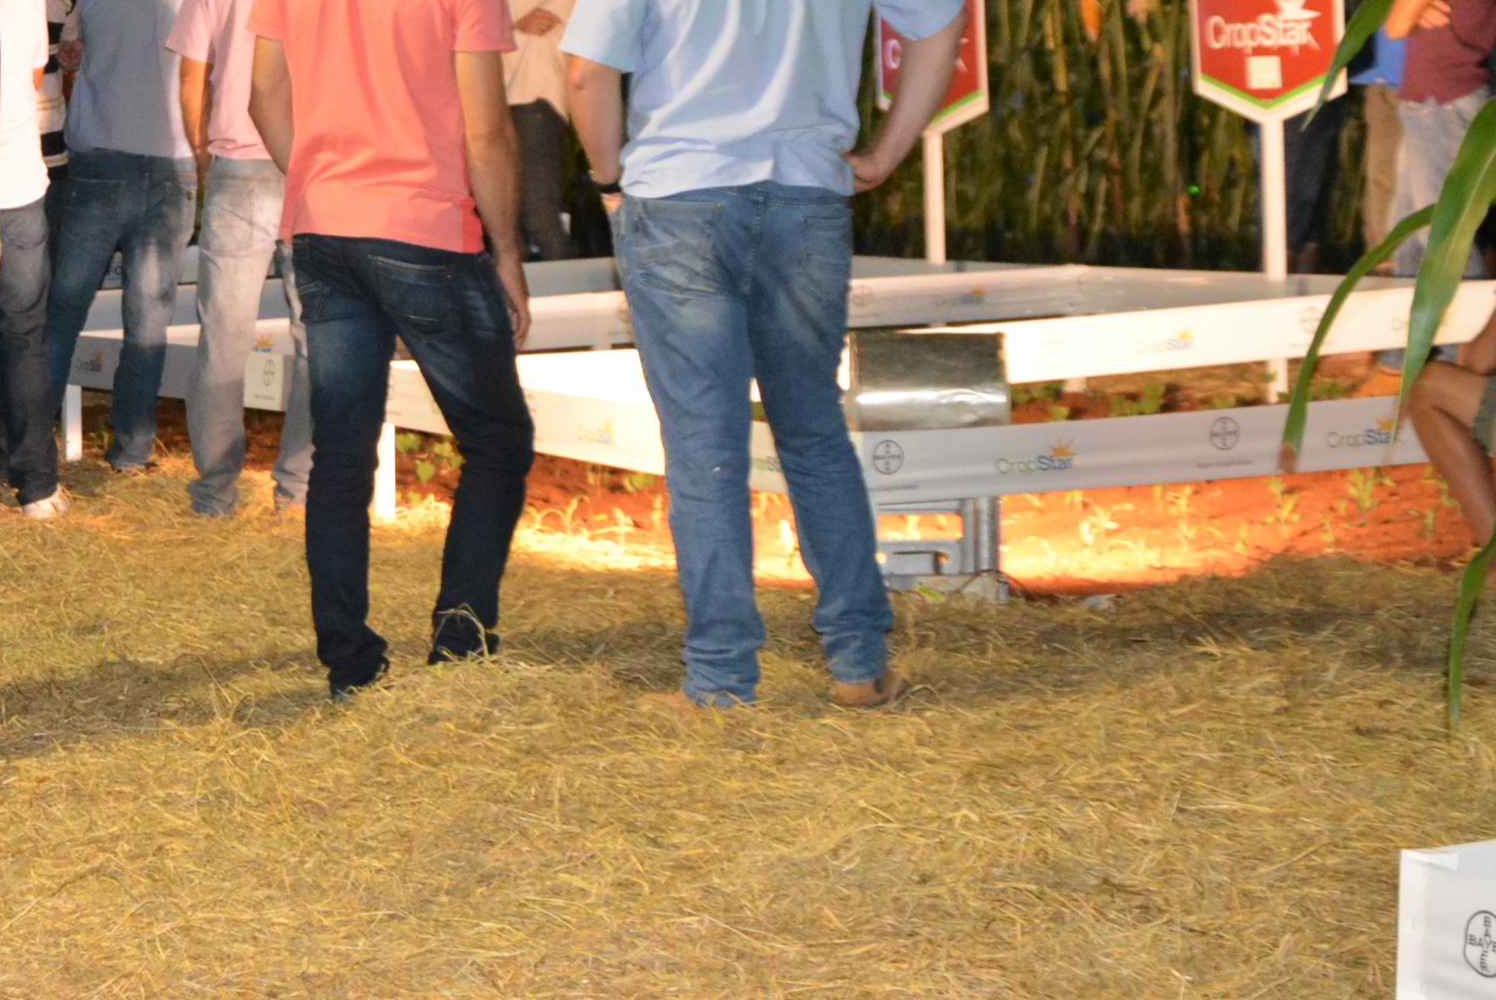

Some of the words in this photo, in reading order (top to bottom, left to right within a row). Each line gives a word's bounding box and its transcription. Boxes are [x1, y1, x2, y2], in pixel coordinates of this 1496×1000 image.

[1204, 12, 1313, 55] CropStar
[1327, 428, 1393, 448] CropSta
[996, 456, 1074, 476] CropStar
